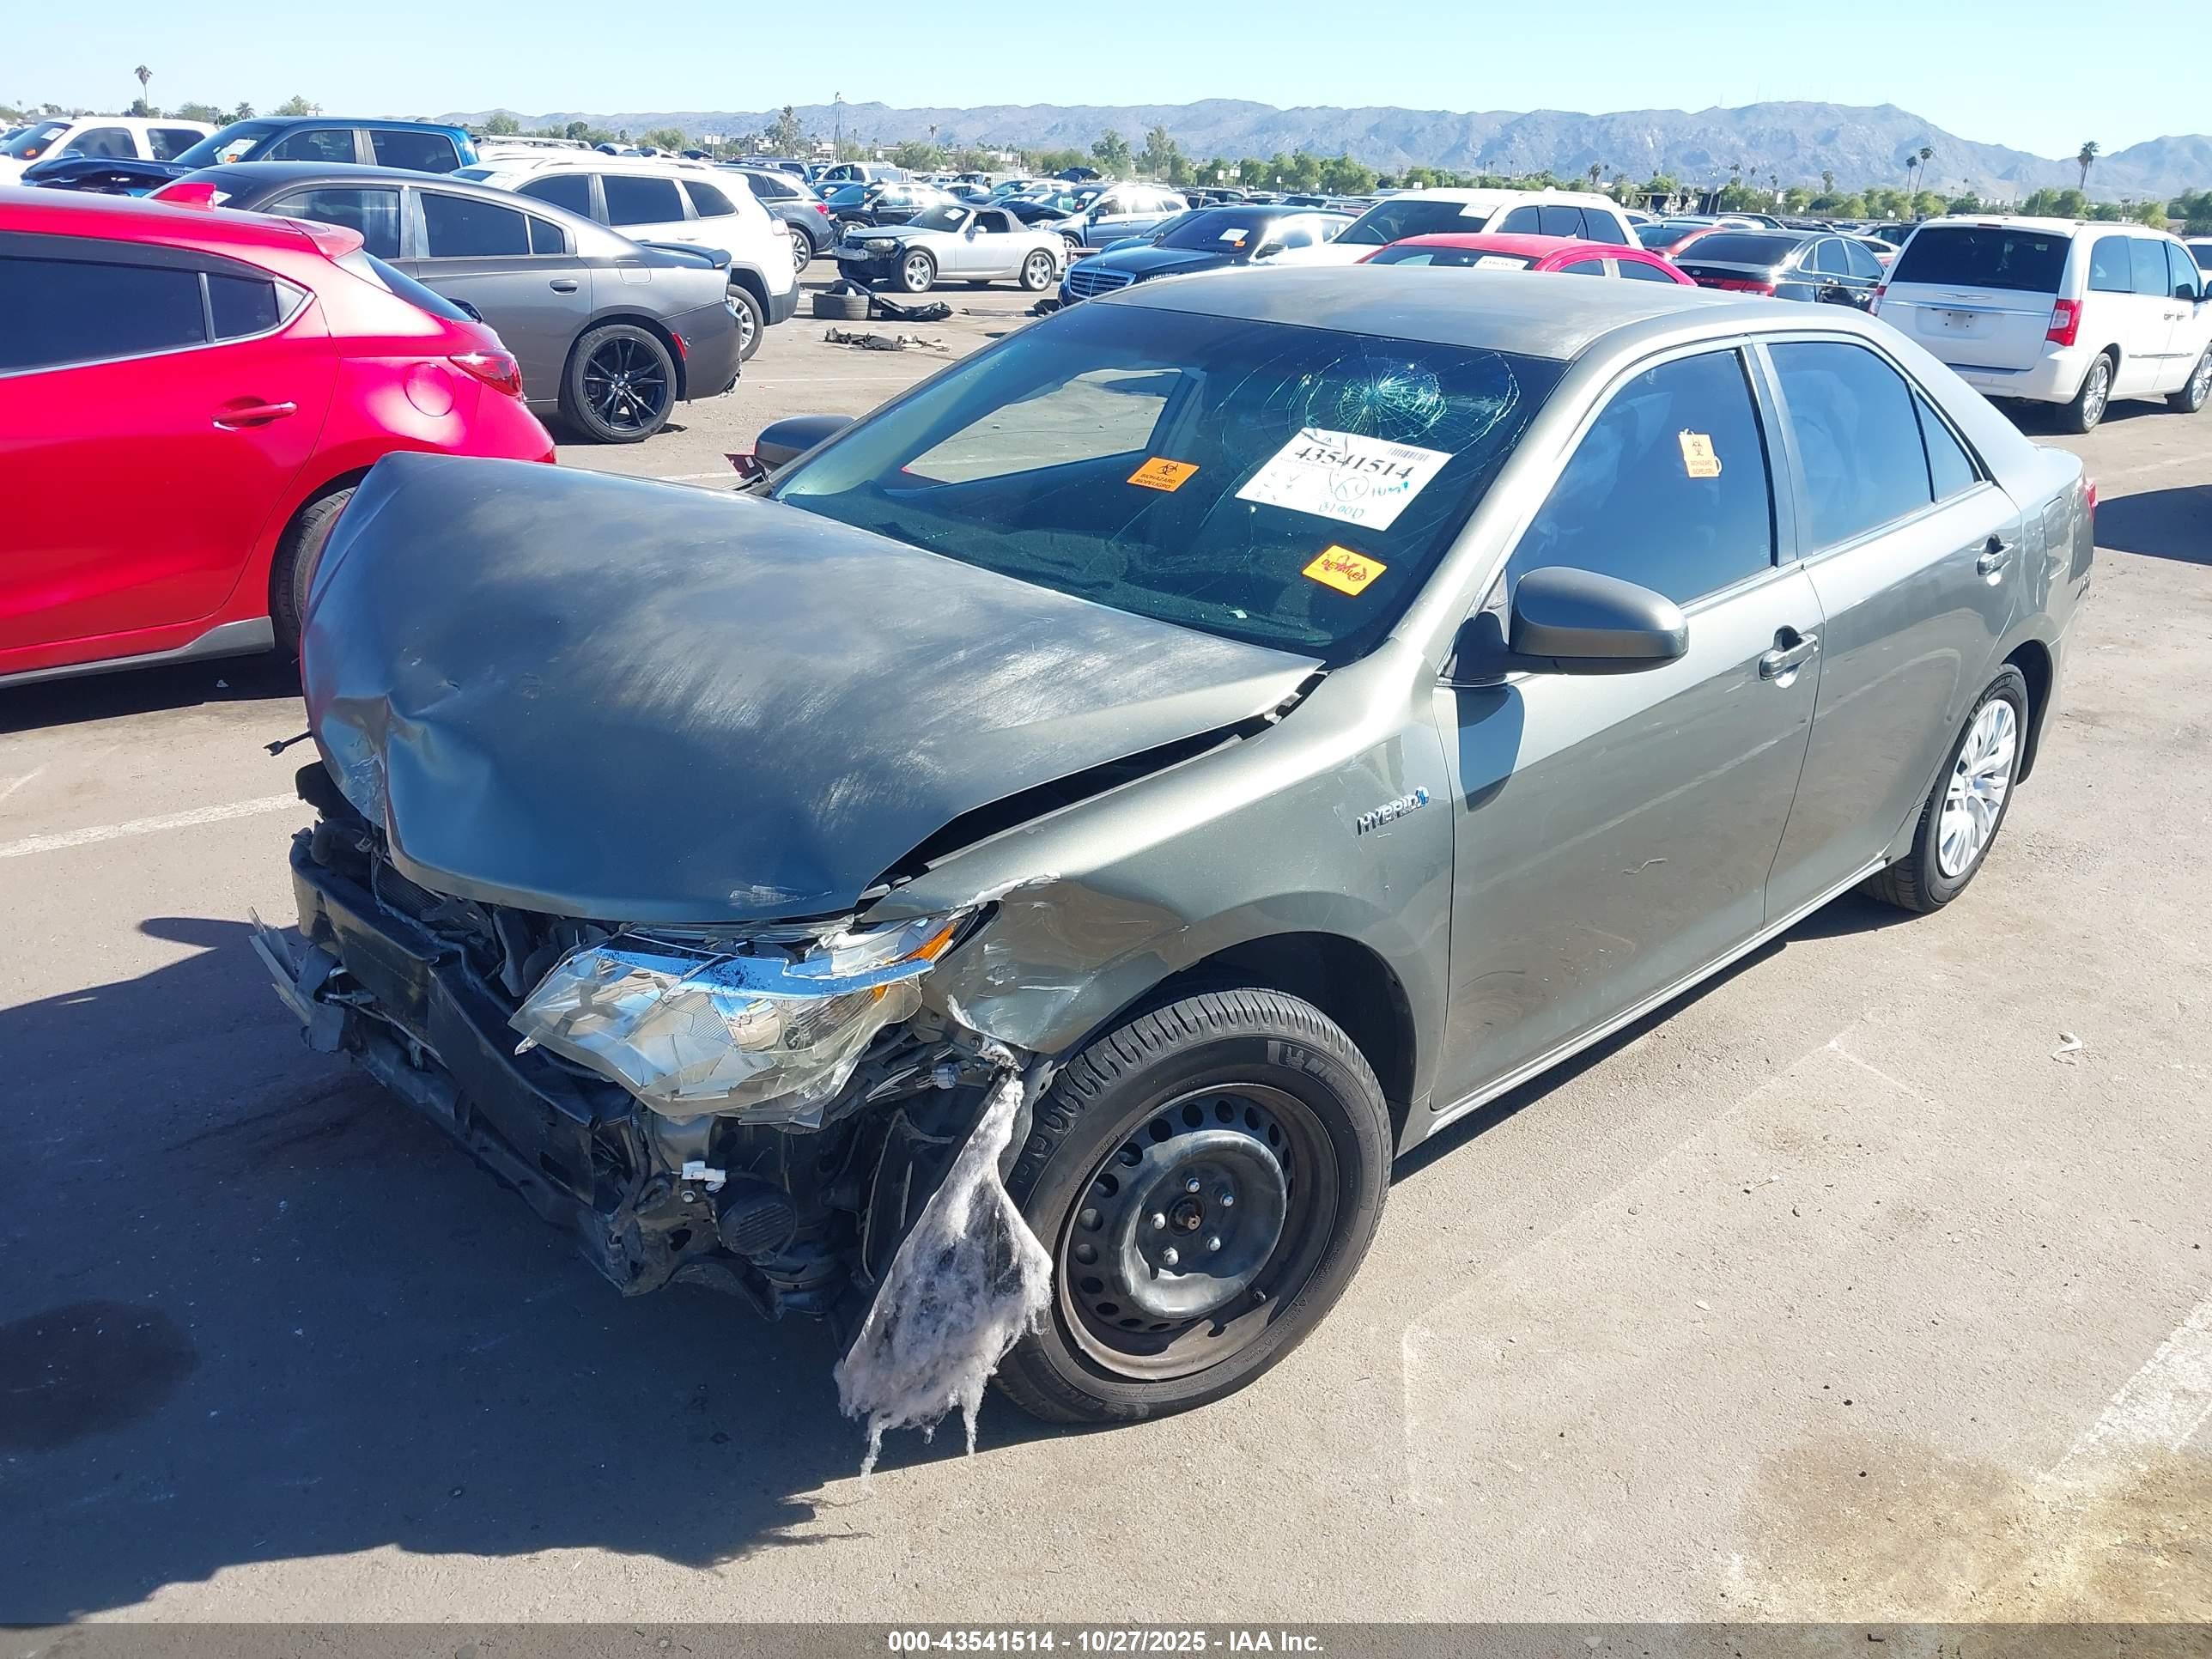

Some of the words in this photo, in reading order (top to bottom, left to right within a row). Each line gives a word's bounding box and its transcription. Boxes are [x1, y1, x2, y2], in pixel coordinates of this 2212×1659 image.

[1139, 473, 1176, 484] BIOHAZARD
[1294, 447, 1414, 479] 43541514
[1357, 795, 1422, 836] HYBRID
[1304, 1057, 1372, 1128] MICHE
